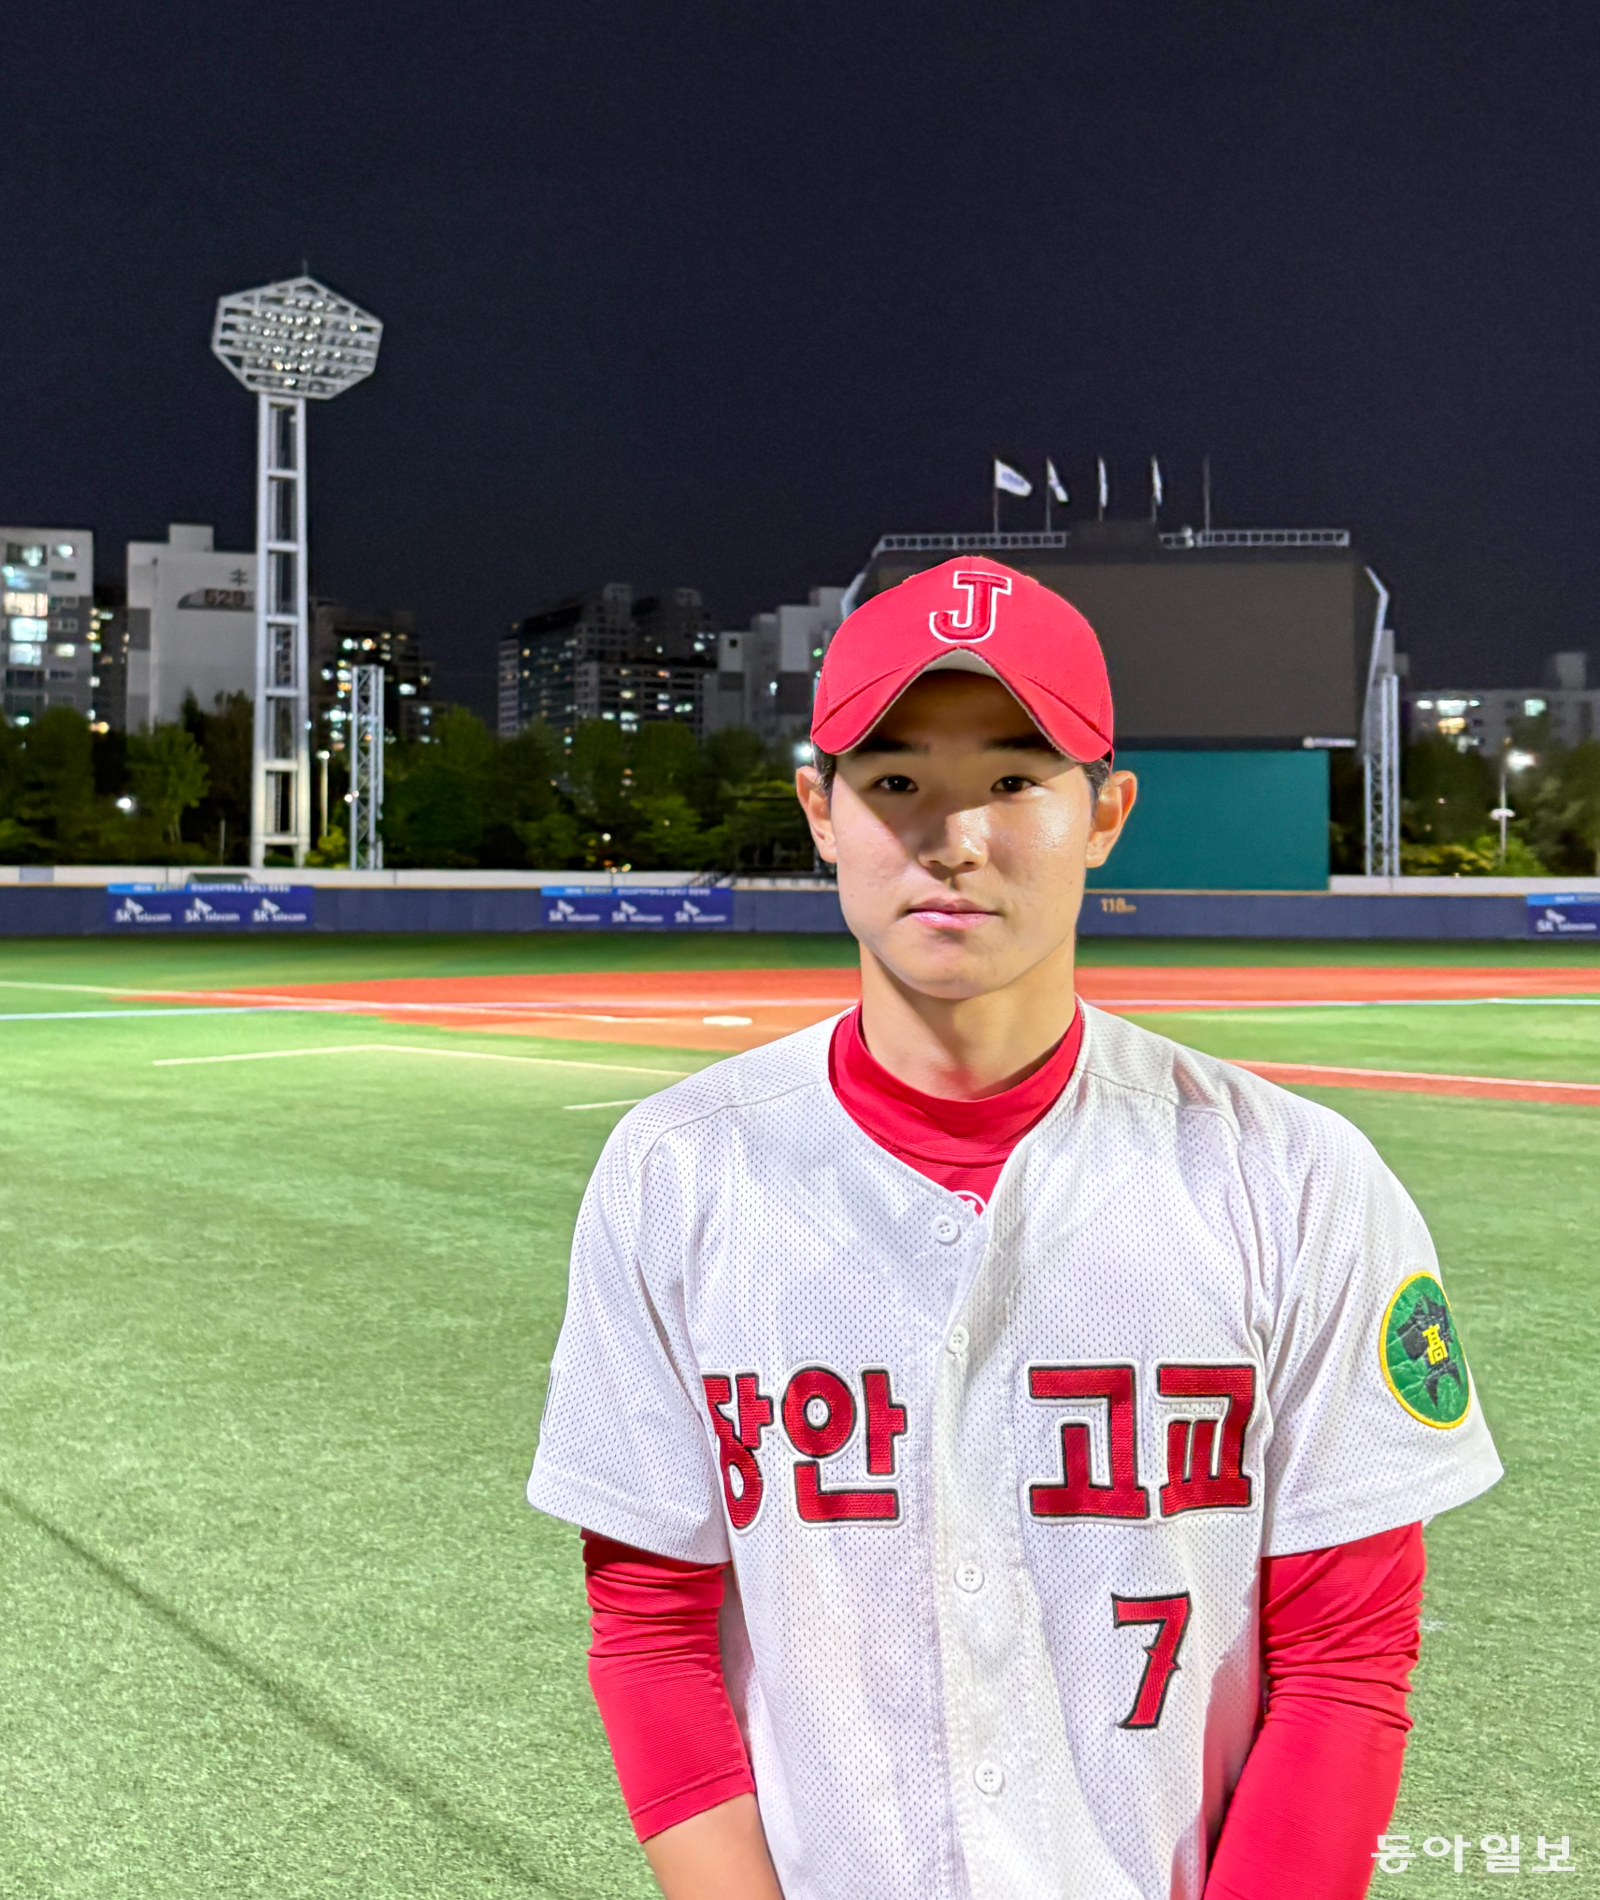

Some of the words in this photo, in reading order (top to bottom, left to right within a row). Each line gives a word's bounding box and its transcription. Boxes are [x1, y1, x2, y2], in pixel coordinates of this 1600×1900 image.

[929, 571, 1012, 644] J
[1027, 1360, 1259, 1528] 고교
[1111, 1591, 1193, 1730] 7
